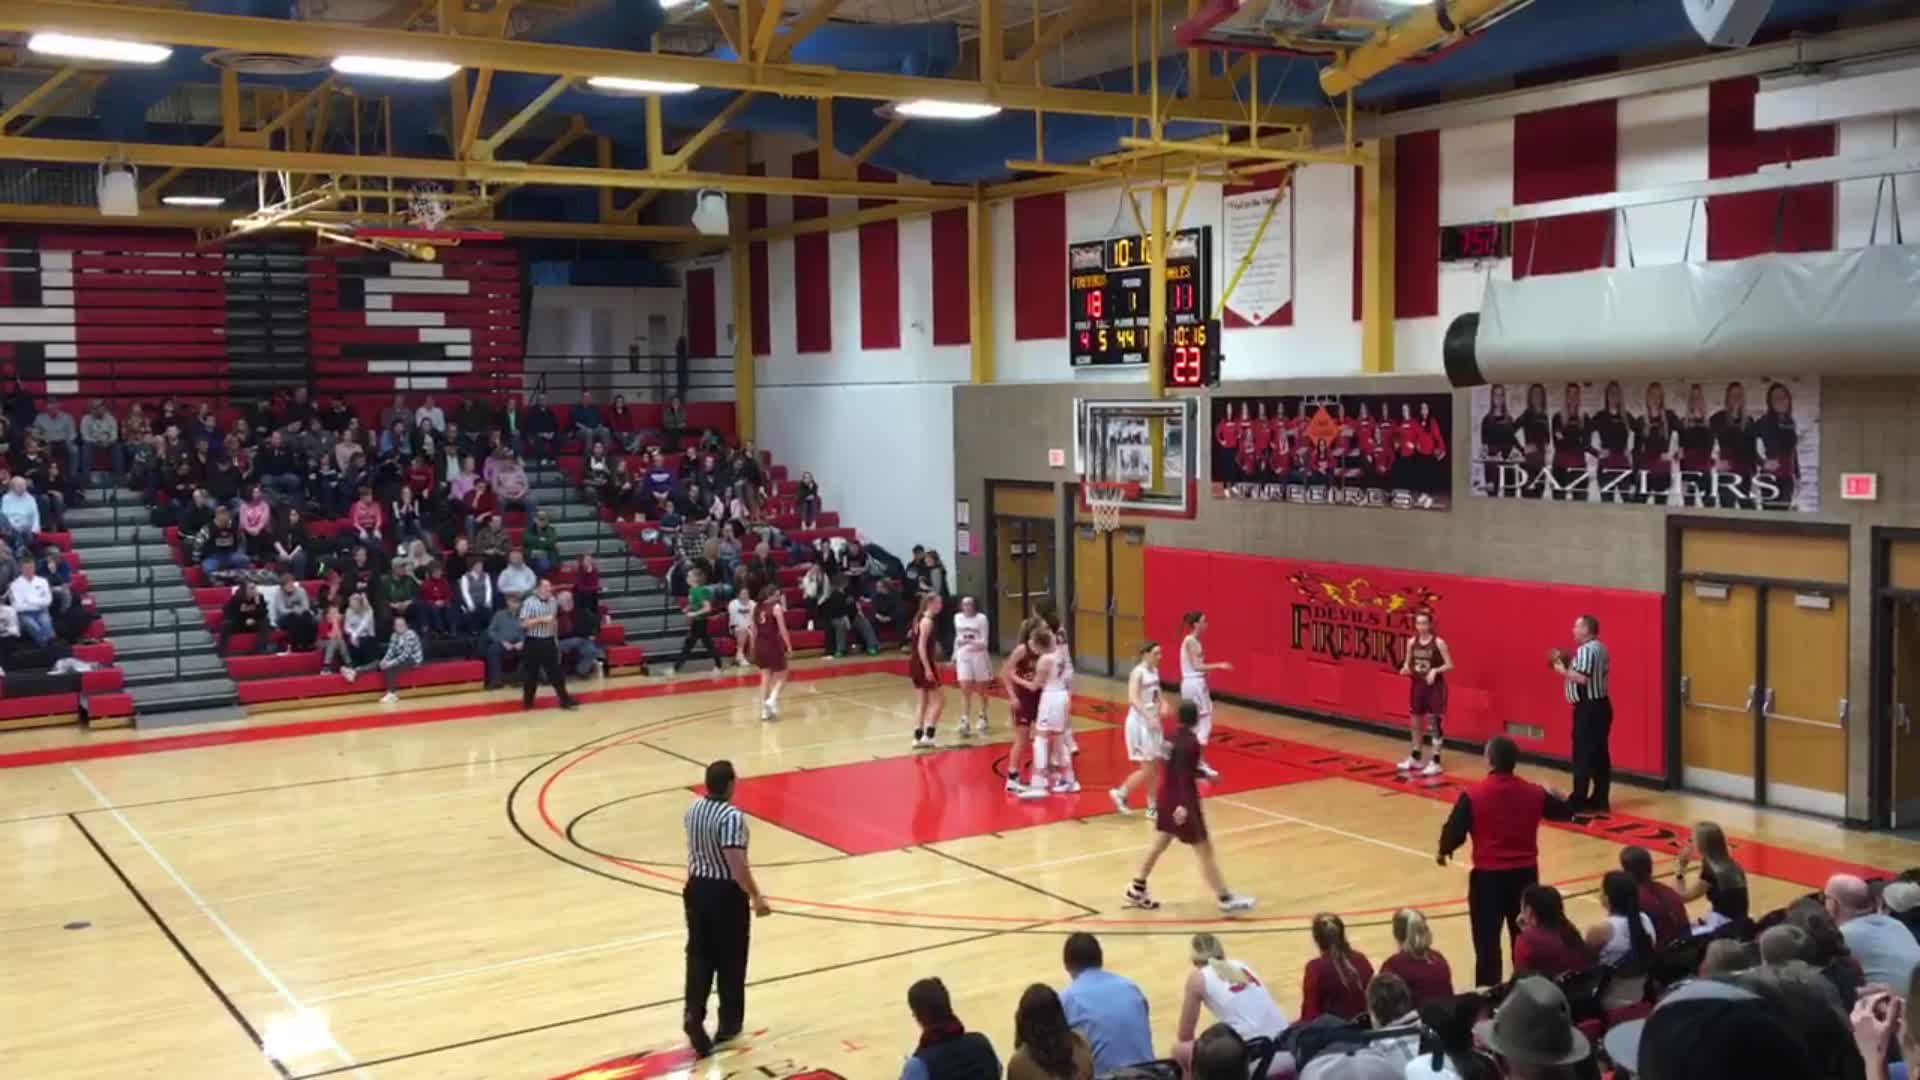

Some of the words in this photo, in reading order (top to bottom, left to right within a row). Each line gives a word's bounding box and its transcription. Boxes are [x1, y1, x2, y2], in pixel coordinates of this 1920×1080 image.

[1087, 291, 1103, 318] 18
[1175, 284, 1193, 310] 11
[1080, 332, 1089, 350] 4
[1099, 329, 1107, 352] 5
[1116, 330, 1135, 349] 44
[1173, 325, 1206, 346] 10:16
[1174, 347, 1200, 382] 23
[1498, 463, 1781, 500] DAZZLERS
